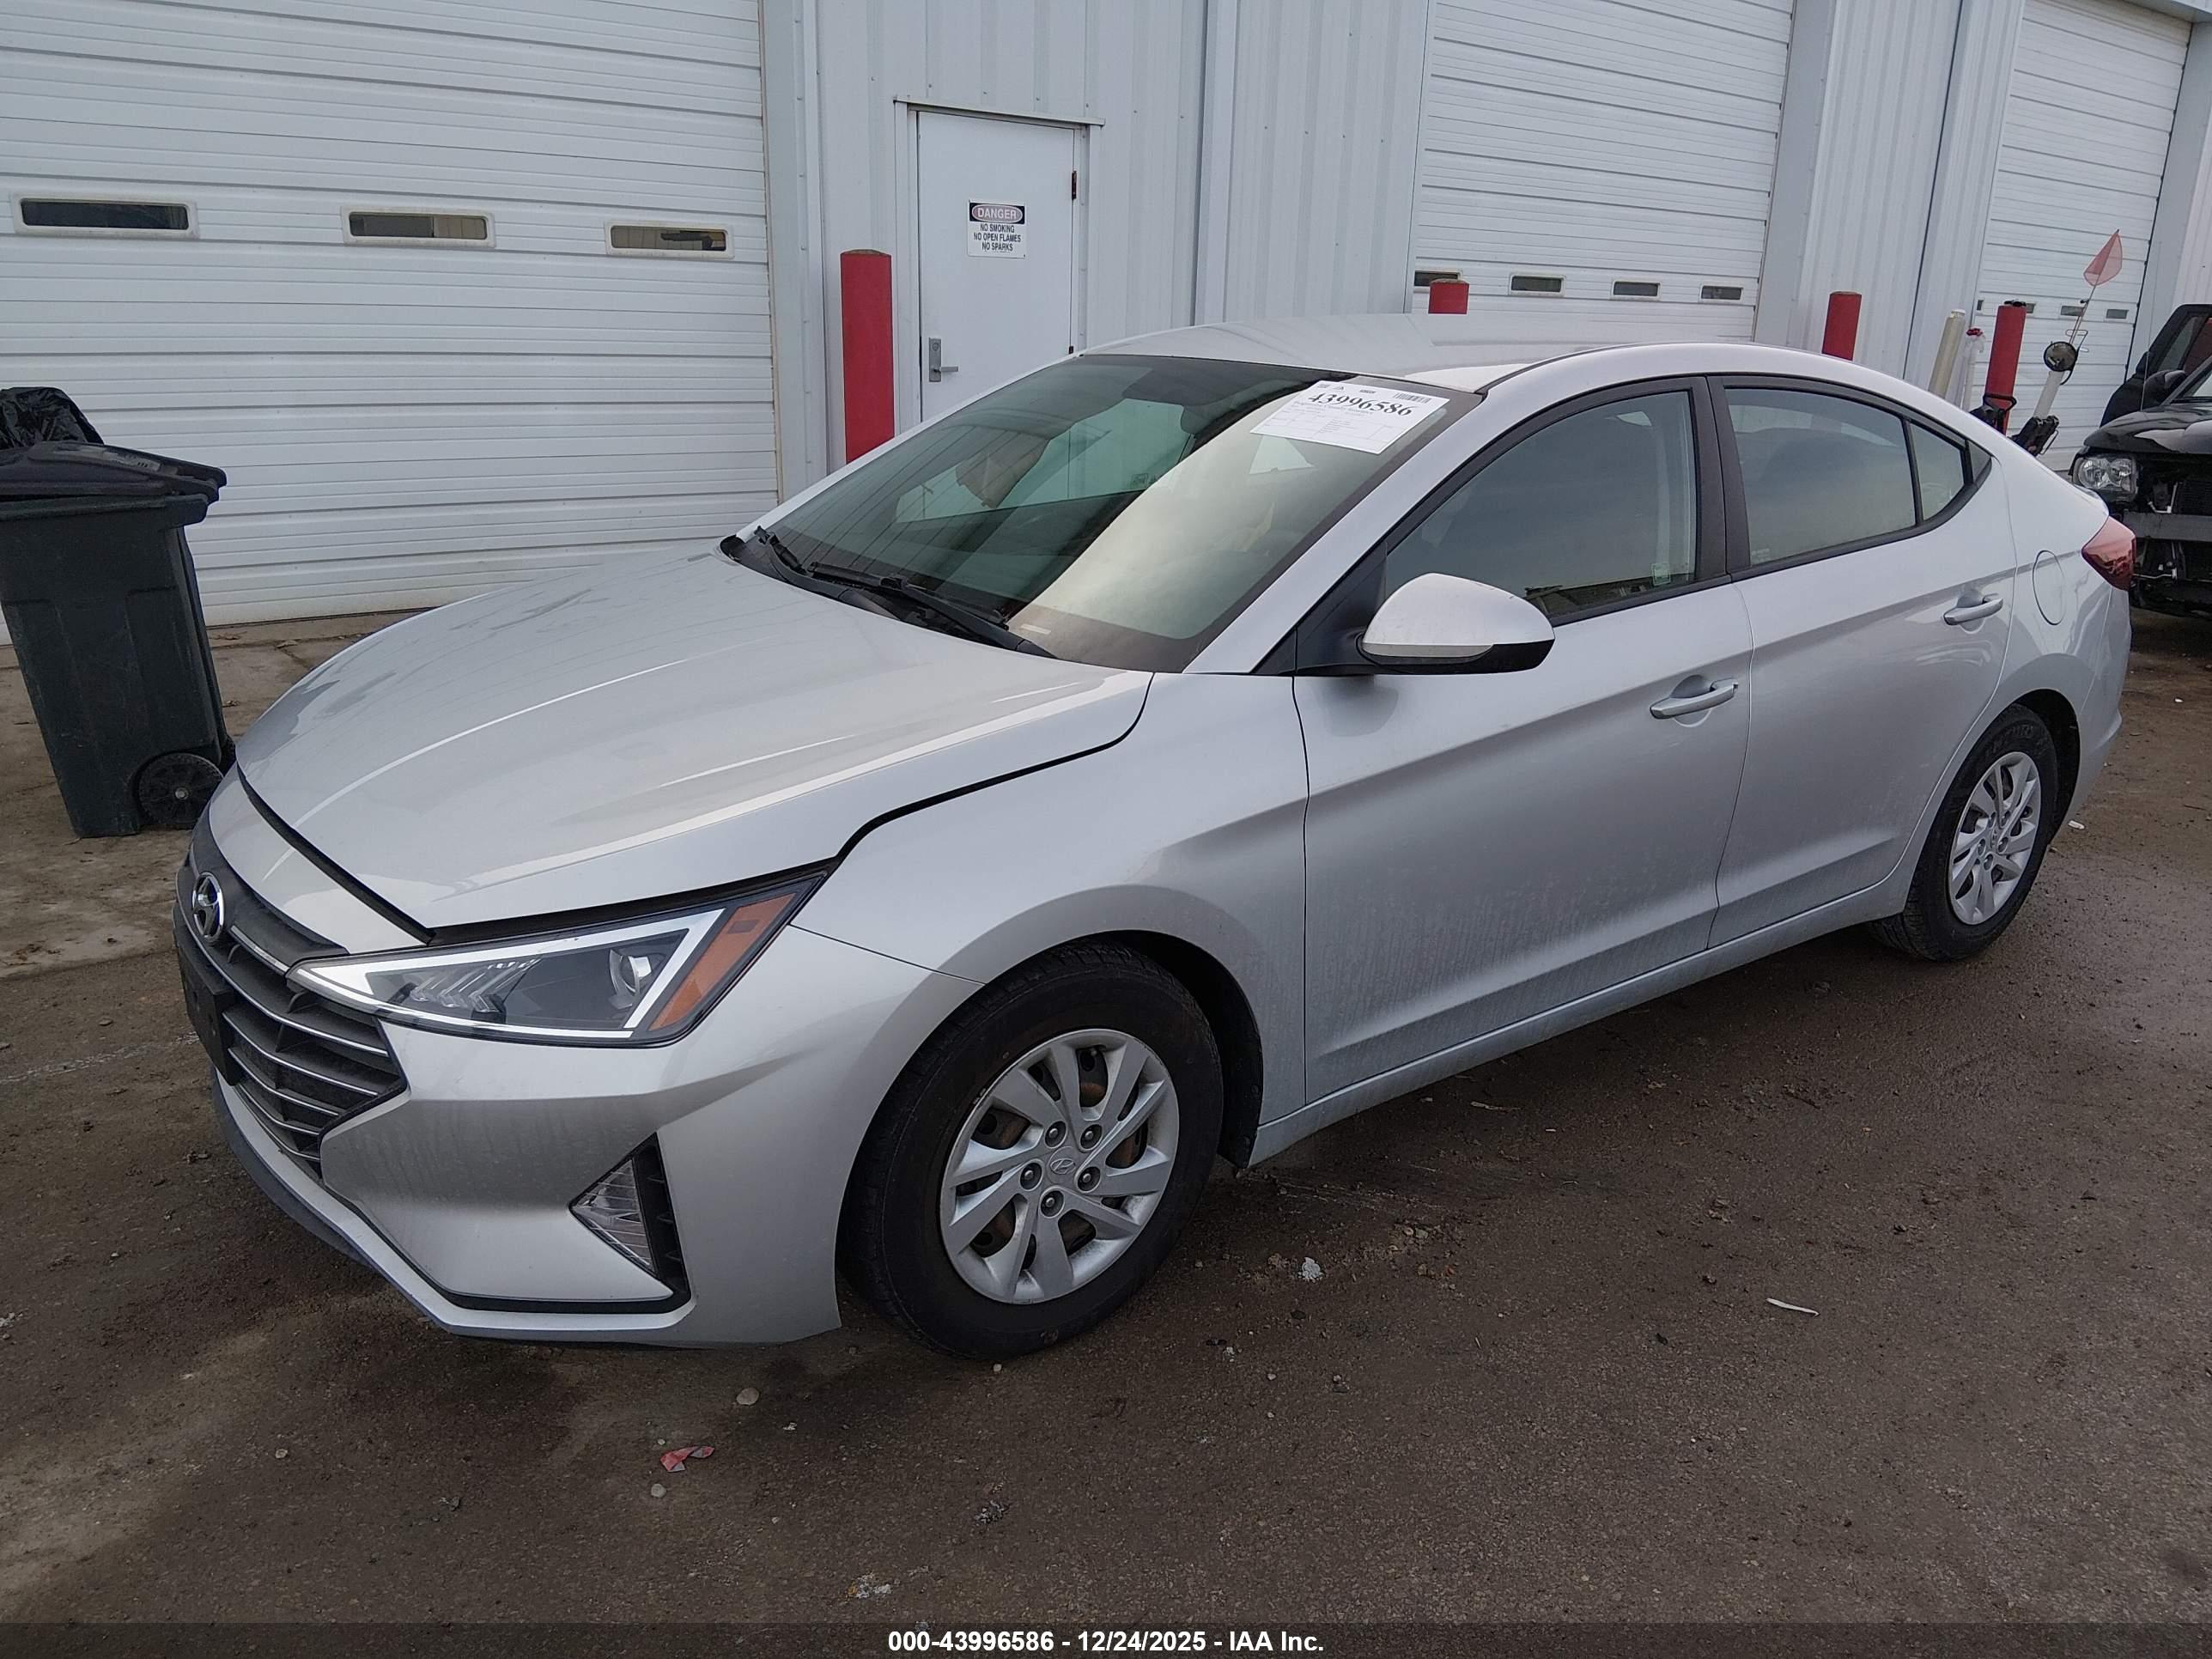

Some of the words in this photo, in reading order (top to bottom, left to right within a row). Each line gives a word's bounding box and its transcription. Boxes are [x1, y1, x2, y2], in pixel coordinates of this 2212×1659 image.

[977, 208, 1017, 220] DANGER
[981, 223, 988, 232] NO
[989, 224, 1015, 233] SMOKING
[973, 232, 981, 240] NO
[983, 233, 999, 241] OPEN
[1000, 234, 1021, 242] FLAMES
[981, 242, 990, 251] NO
[991, 242, 1013, 251] SPARKS
[1308, 392, 1413, 416] 43996586
